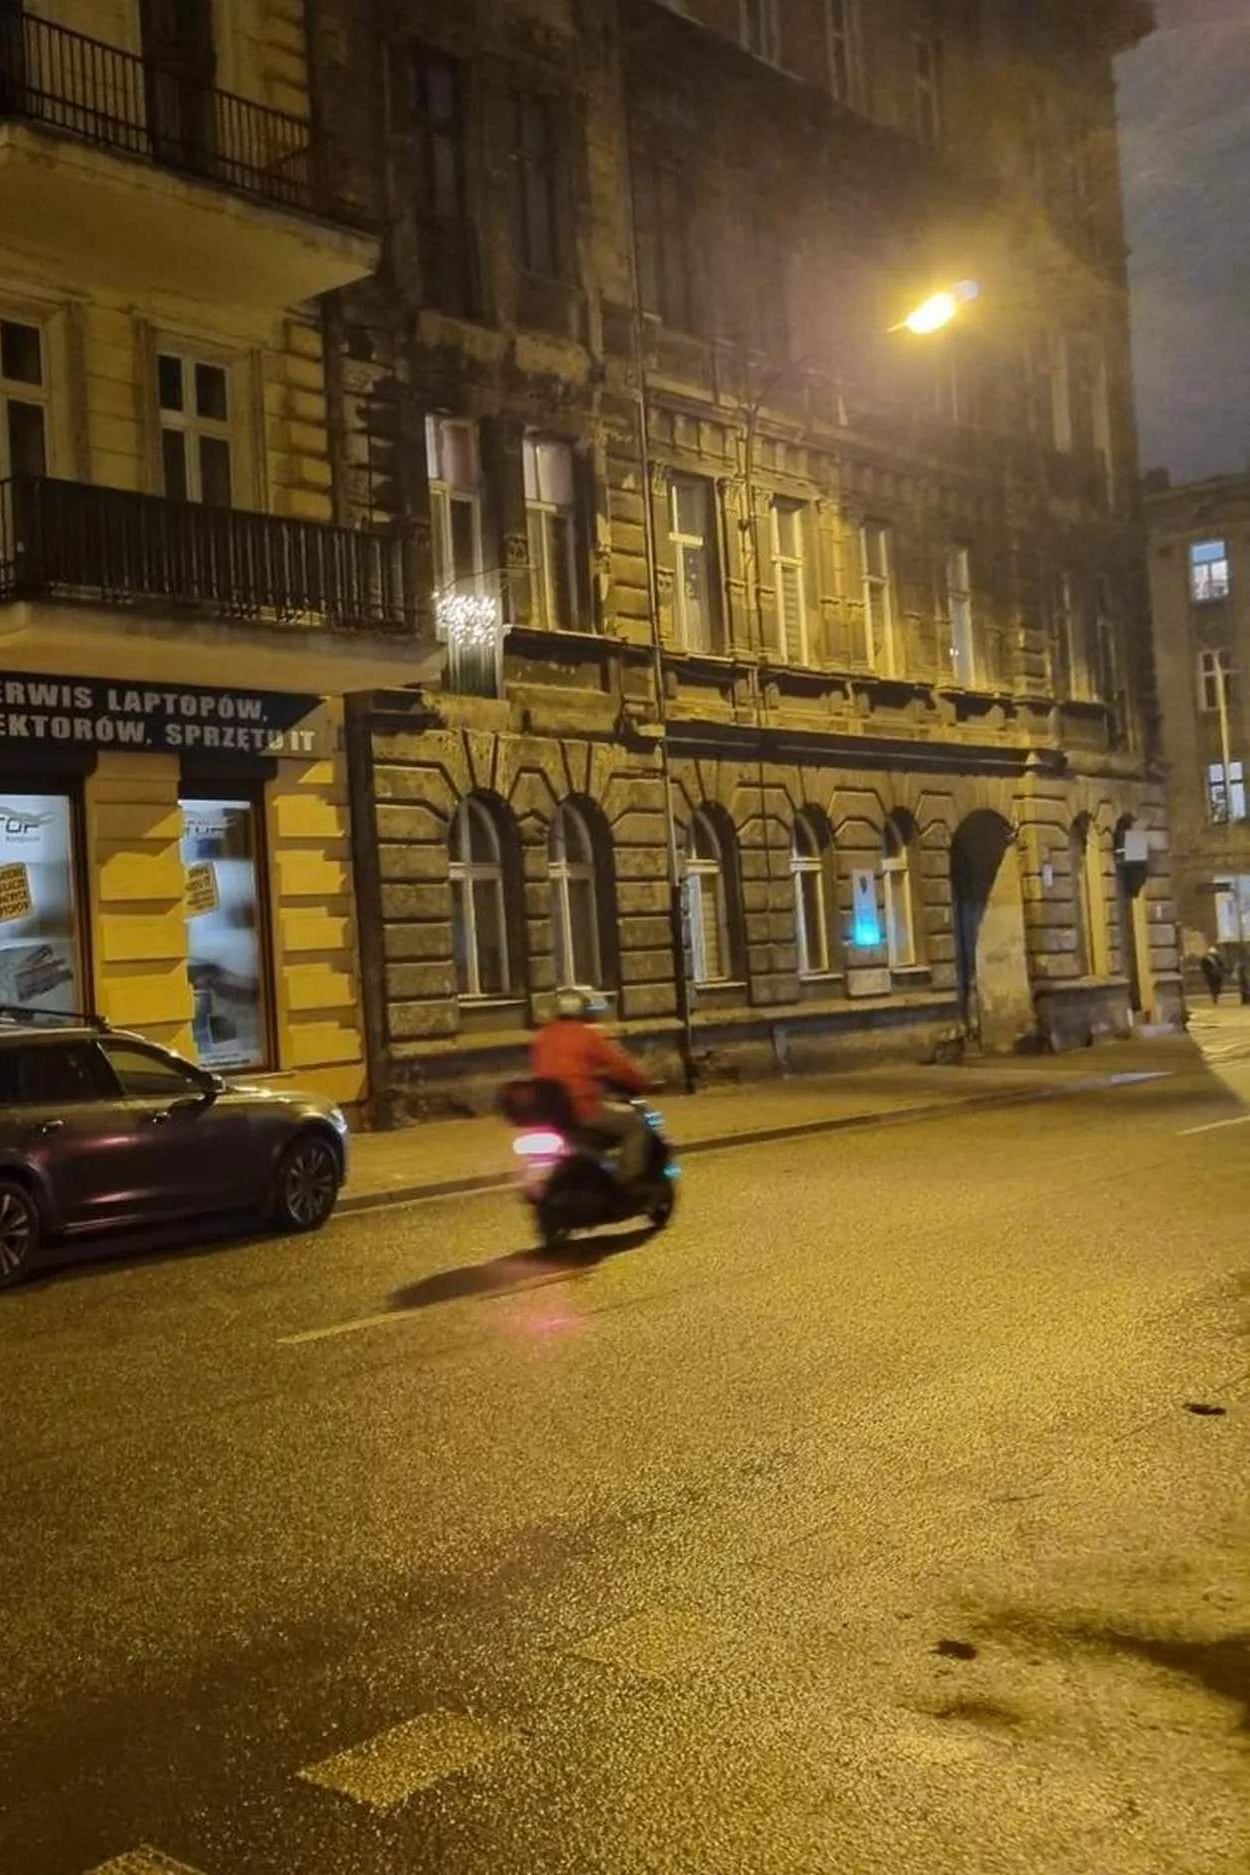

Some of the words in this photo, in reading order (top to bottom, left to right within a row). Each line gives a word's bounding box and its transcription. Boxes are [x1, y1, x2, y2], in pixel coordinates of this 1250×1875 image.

[107, 688, 269, 722] LAPTOPÓW,
[164, 723, 285, 752] SPRZĘTU
[290, 730, 316, 751] IT
